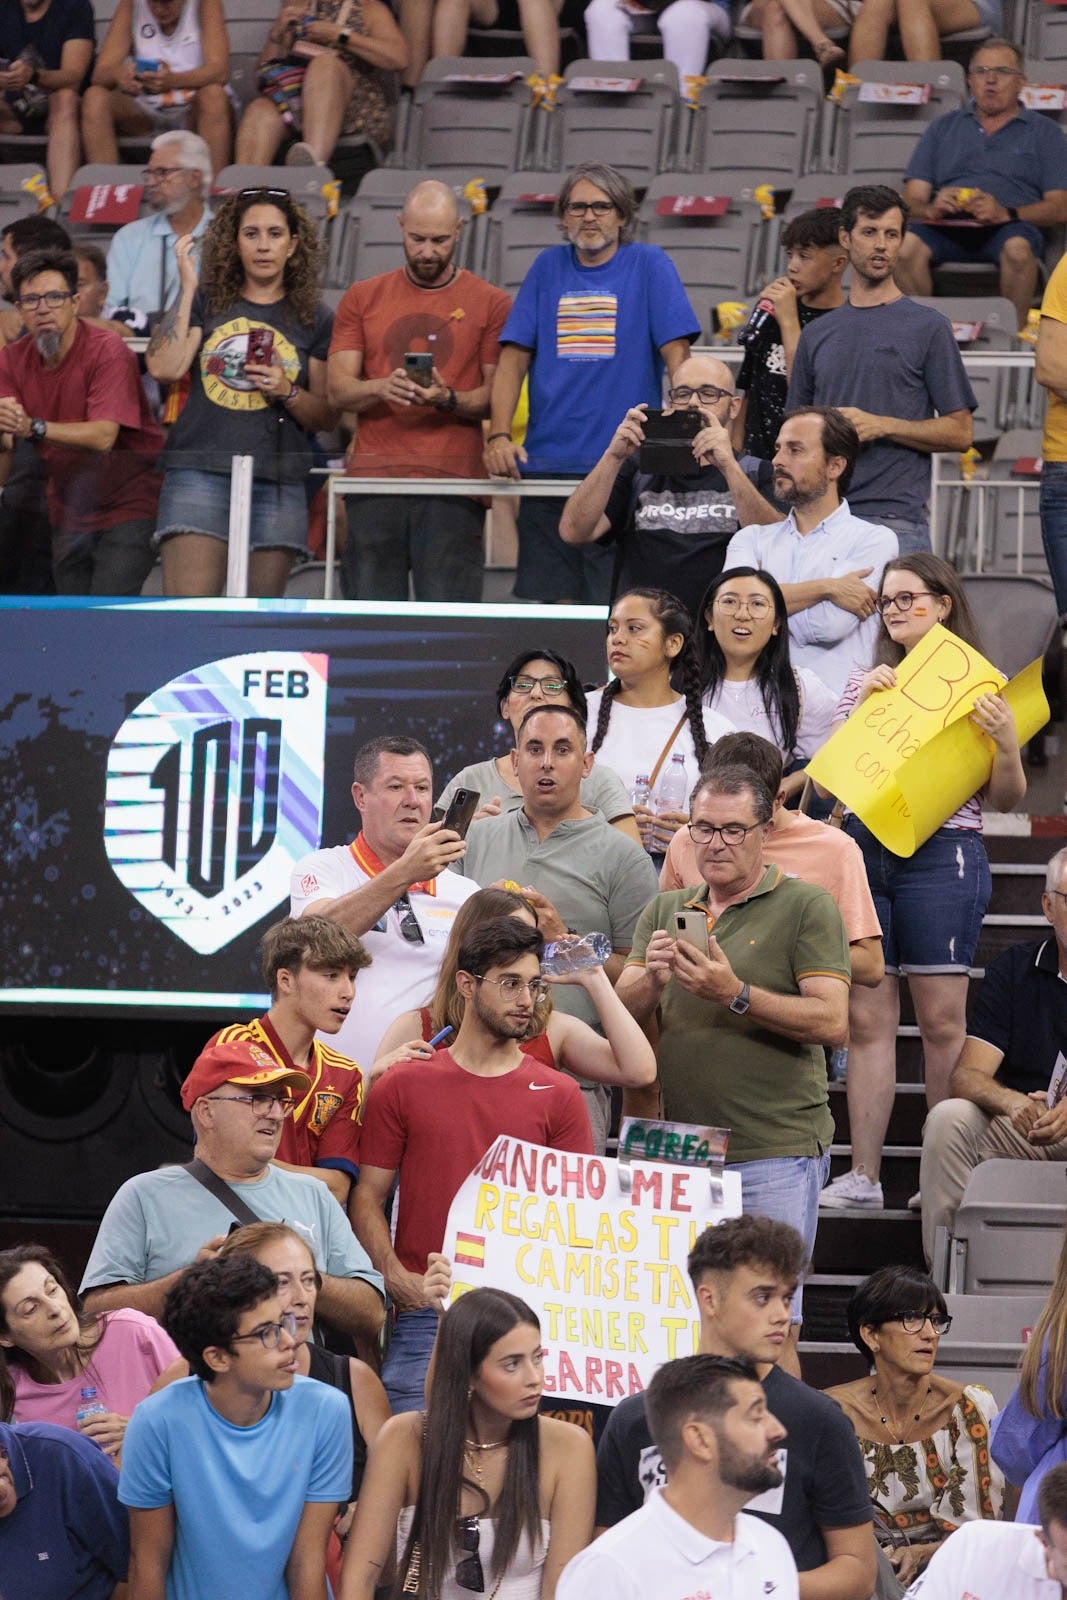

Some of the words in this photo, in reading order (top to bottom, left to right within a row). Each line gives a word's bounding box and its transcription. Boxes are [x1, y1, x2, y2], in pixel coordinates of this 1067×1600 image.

[242, 669, 309, 699] FEB
[854, 751, 891, 791] con
[222, 881, 262, 916] 2023
[631, 1169, 692, 1212] ME
[473, 1182, 639, 1254] REGALAS
[543, 1302, 649, 1354] TENER
